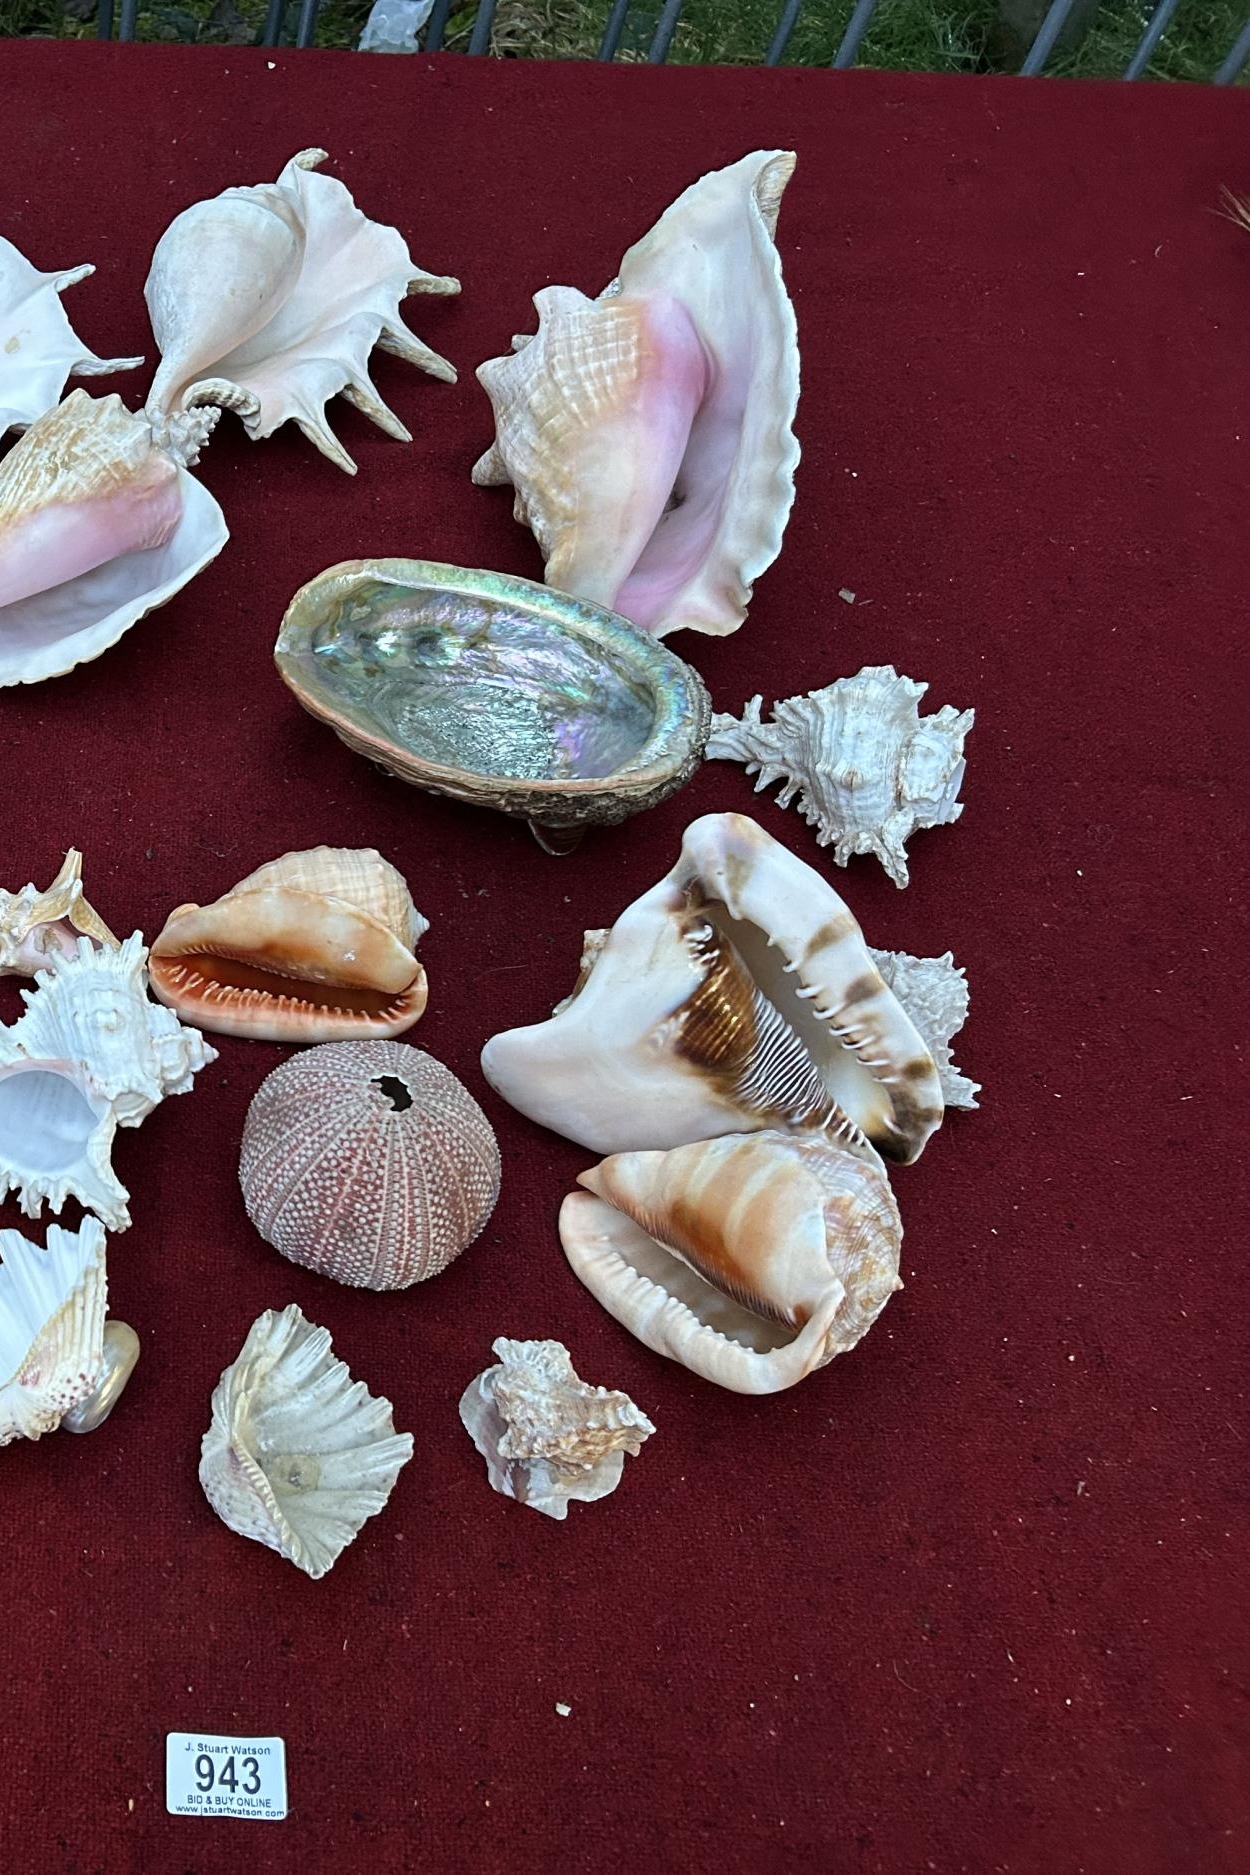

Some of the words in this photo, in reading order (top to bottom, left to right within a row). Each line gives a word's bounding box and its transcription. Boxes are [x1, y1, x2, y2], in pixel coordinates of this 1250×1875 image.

[184, 1742, 195, 1752] J.
[197, 1742, 229, 1754] Stuart
[231, 1745, 271, 1756] Watson
[195, 1754, 262, 1795] 943
[187, 1794, 203, 1805] BID
[205, 1795, 213, 1805] &
[214, 1796, 235, 1805] BUY
[236, 1797, 272, 1808] ONLINE
